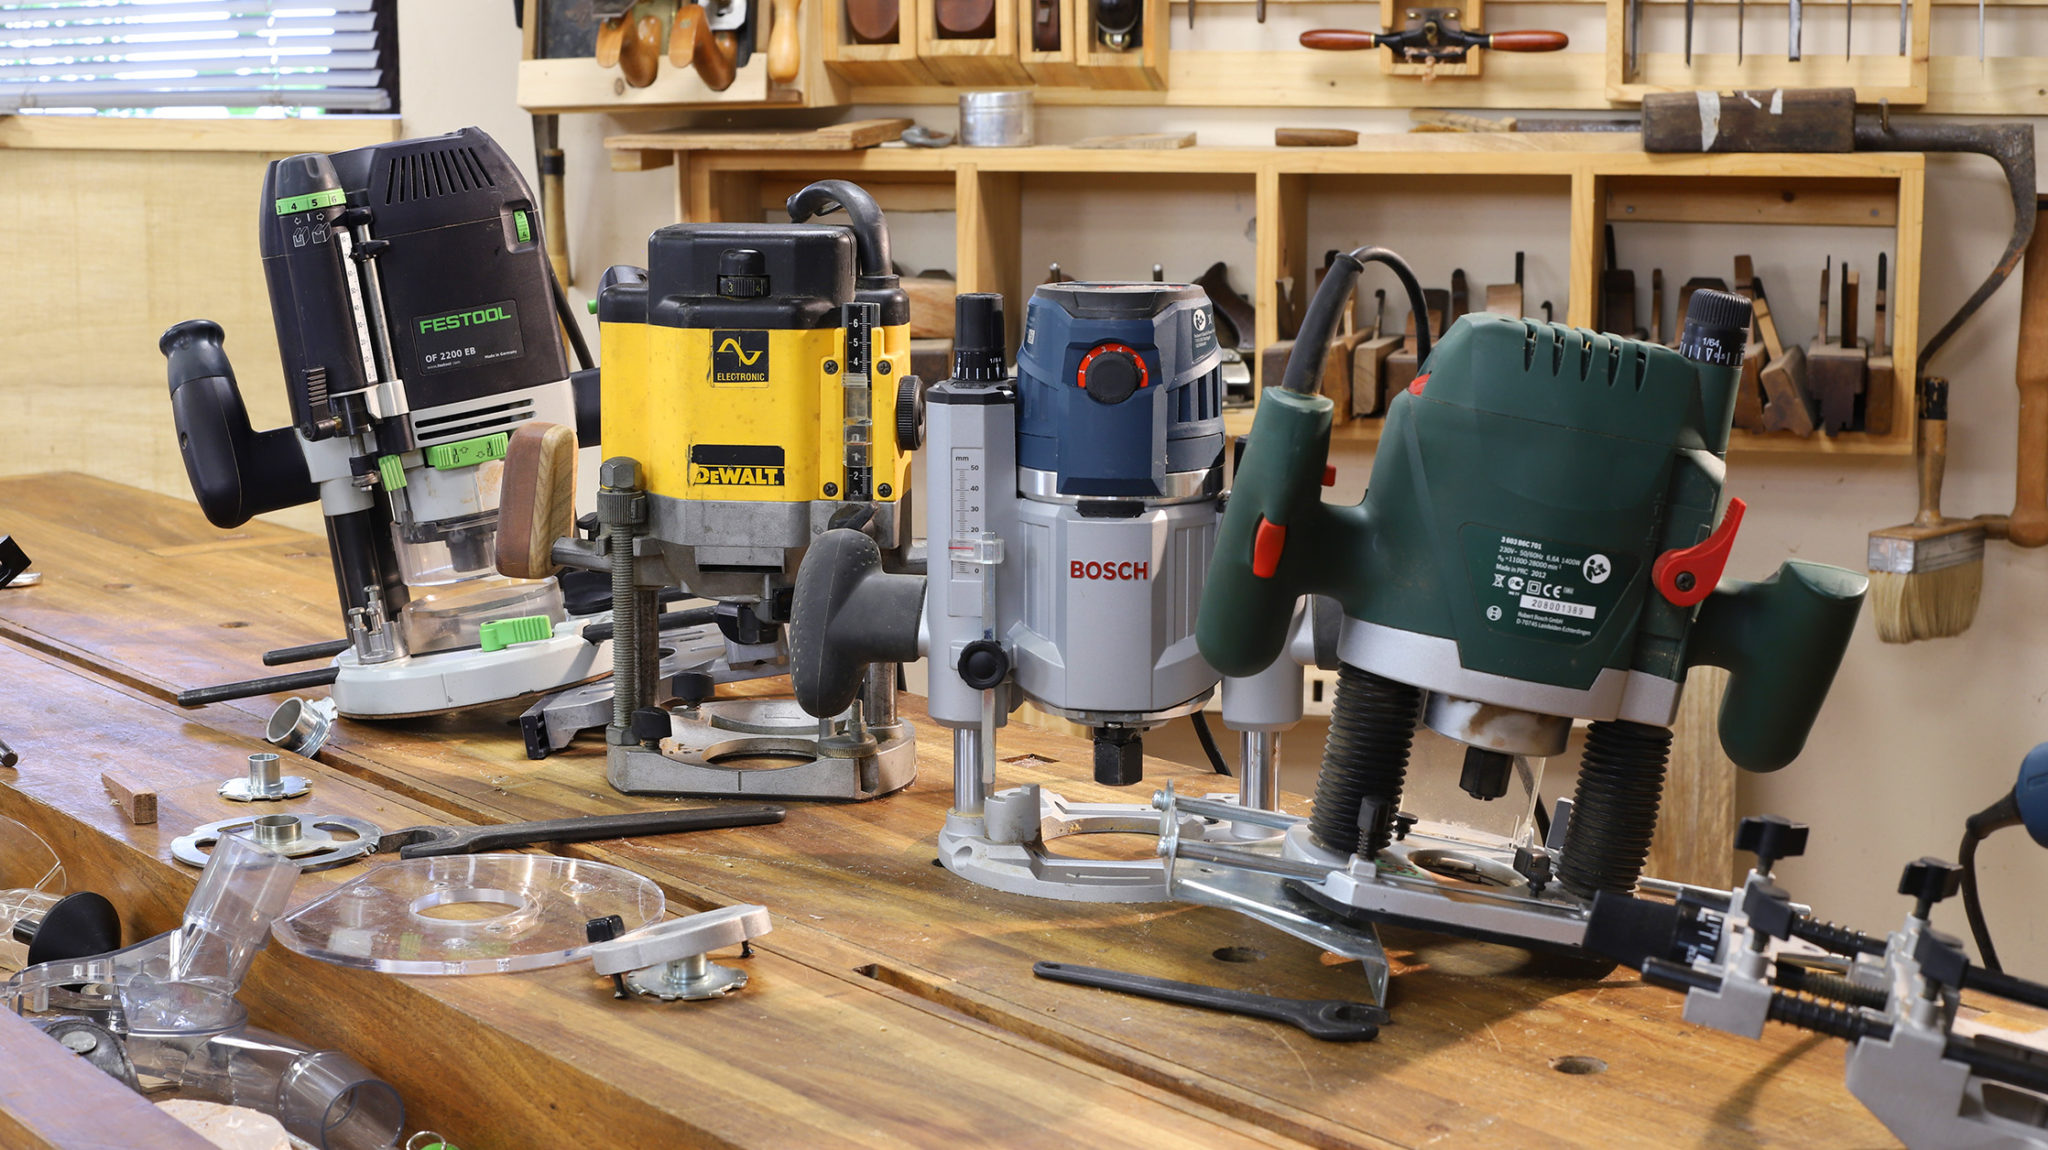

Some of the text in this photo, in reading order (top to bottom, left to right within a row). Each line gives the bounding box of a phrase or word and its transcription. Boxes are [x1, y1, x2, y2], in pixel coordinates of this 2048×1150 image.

[311, 199, 318, 207] 5
[728, 282, 734, 293] 3
[420, 307, 511, 334] FESTOOL
[853, 318, 859, 328] 6
[853, 338, 859, 347] 5
[1703, 337, 1720, 347] 1/64
[425, 347, 476, 363] OF 2200 EB
[853, 357, 859, 366] 4
[717, 373, 765, 381] ELECTRONIC
[853, 471, 859, 480] 2
[1530, 542, 1542, 550] 701
[1561, 557, 1581, 566] 1400W
[1070, 560, 1149, 580] BOSCH
[1496, 563, 1511, 572] Made
[1531, 569, 1547, 578] 2012
[1543, 584, 1562, 598] CE
